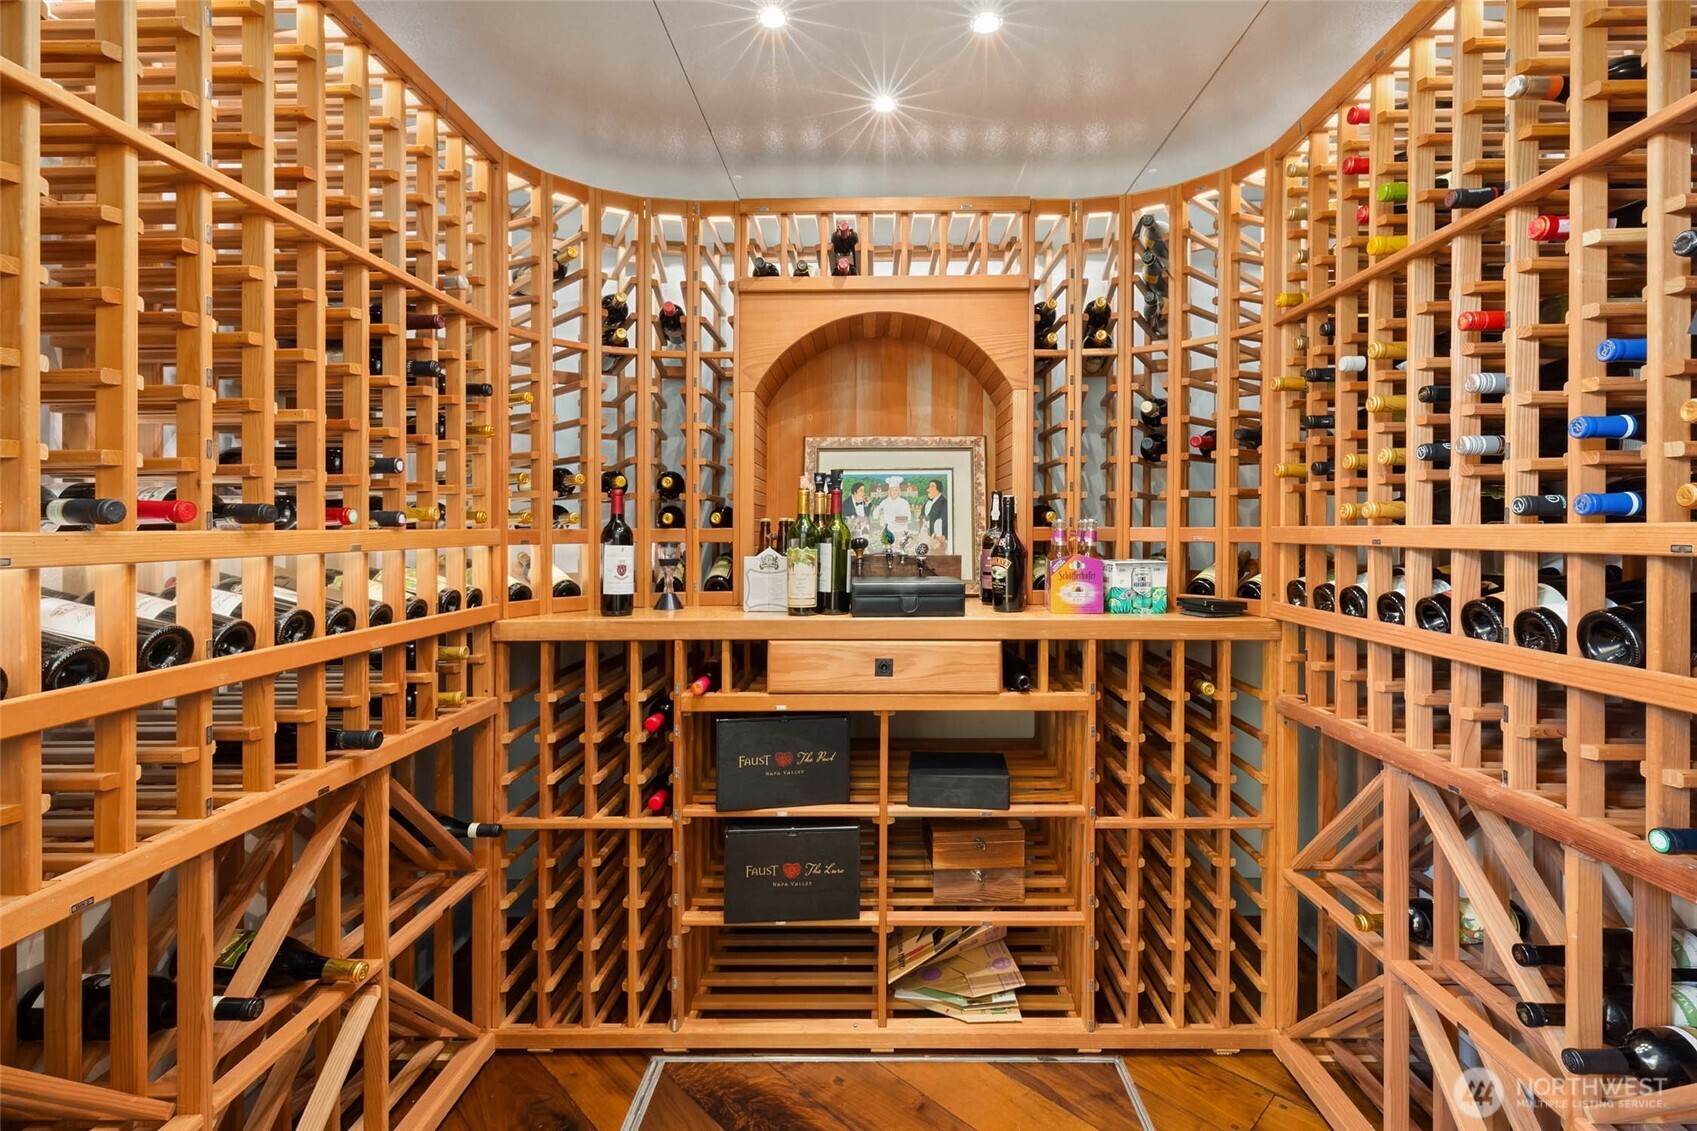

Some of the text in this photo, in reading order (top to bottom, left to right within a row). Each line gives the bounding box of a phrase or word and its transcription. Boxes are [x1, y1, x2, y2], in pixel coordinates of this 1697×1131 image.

[738, 754, 771, 769] FAUST
[796, 751, 814, 765] The
[745, 862, 845, 878] FAUST The Lure
